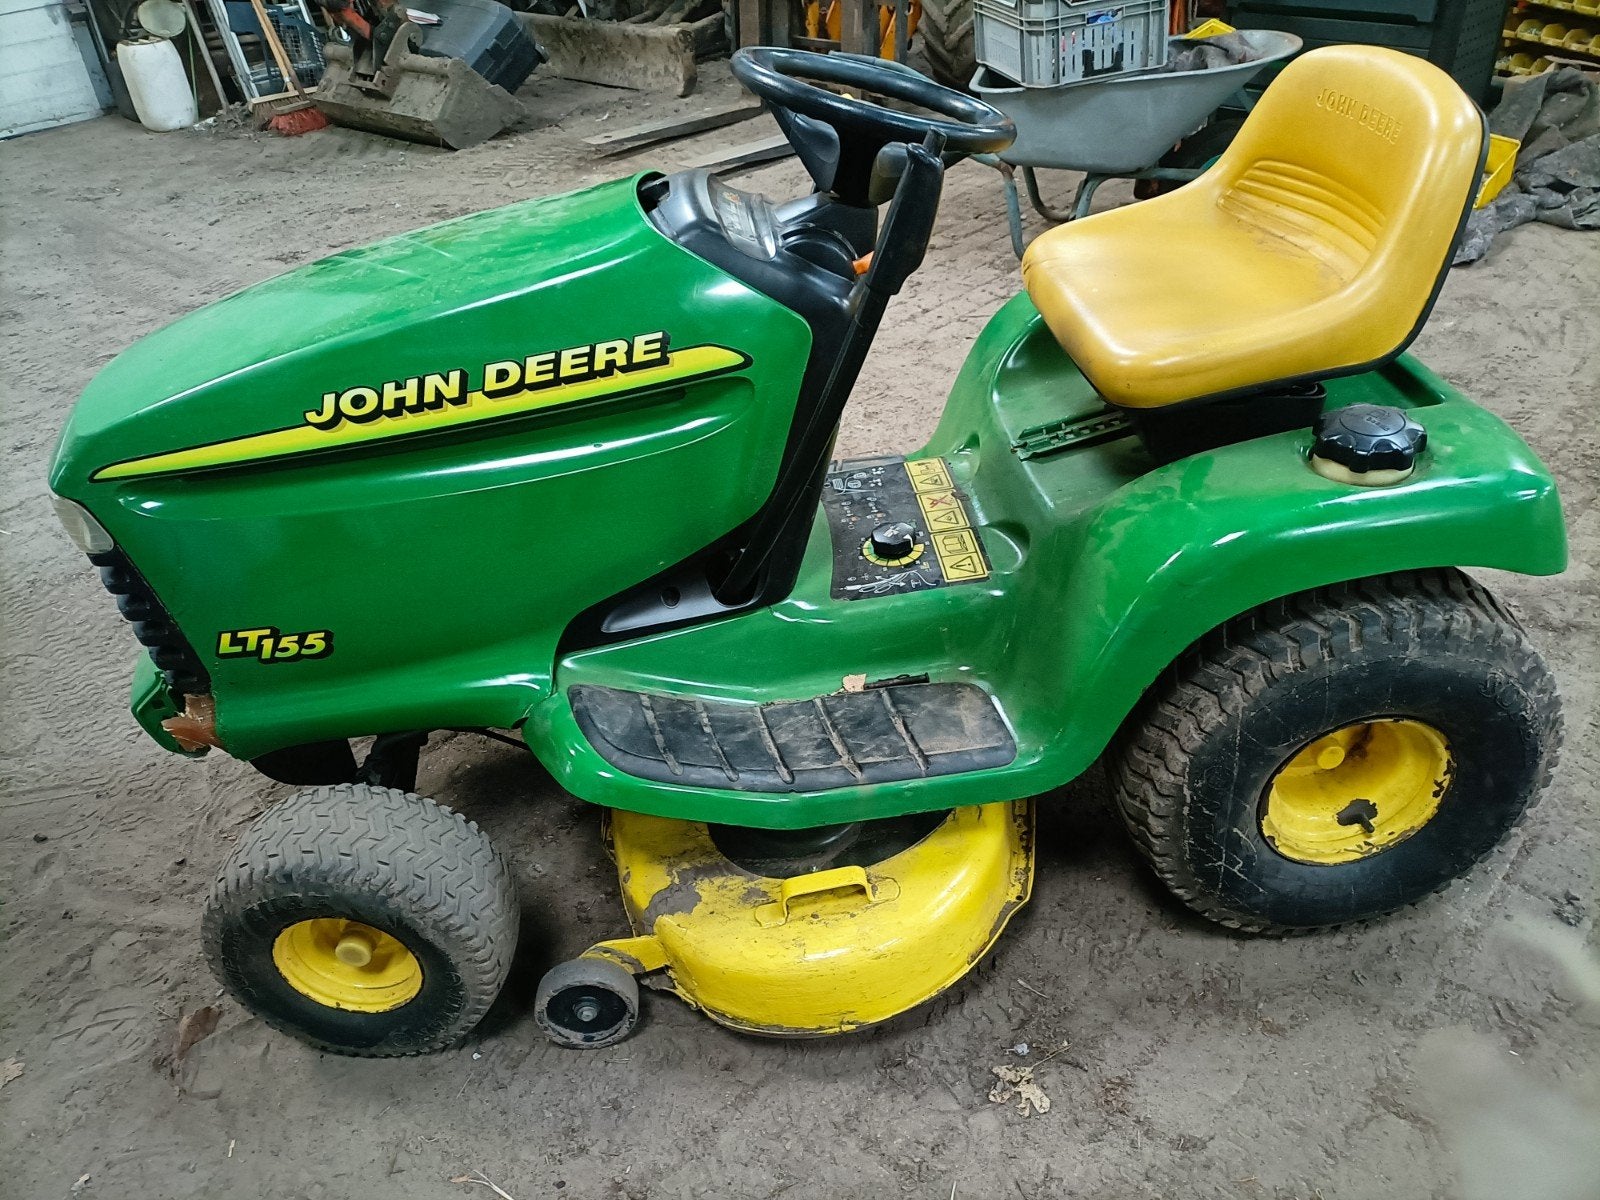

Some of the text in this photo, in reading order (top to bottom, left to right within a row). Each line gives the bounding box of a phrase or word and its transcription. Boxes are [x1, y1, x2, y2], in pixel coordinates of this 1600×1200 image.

[1316, 88, 1402, 145] JOHN DEERE
[304, 331, 668, 425] JOHN DEERE
[217, 627, 330, 662] LT155
